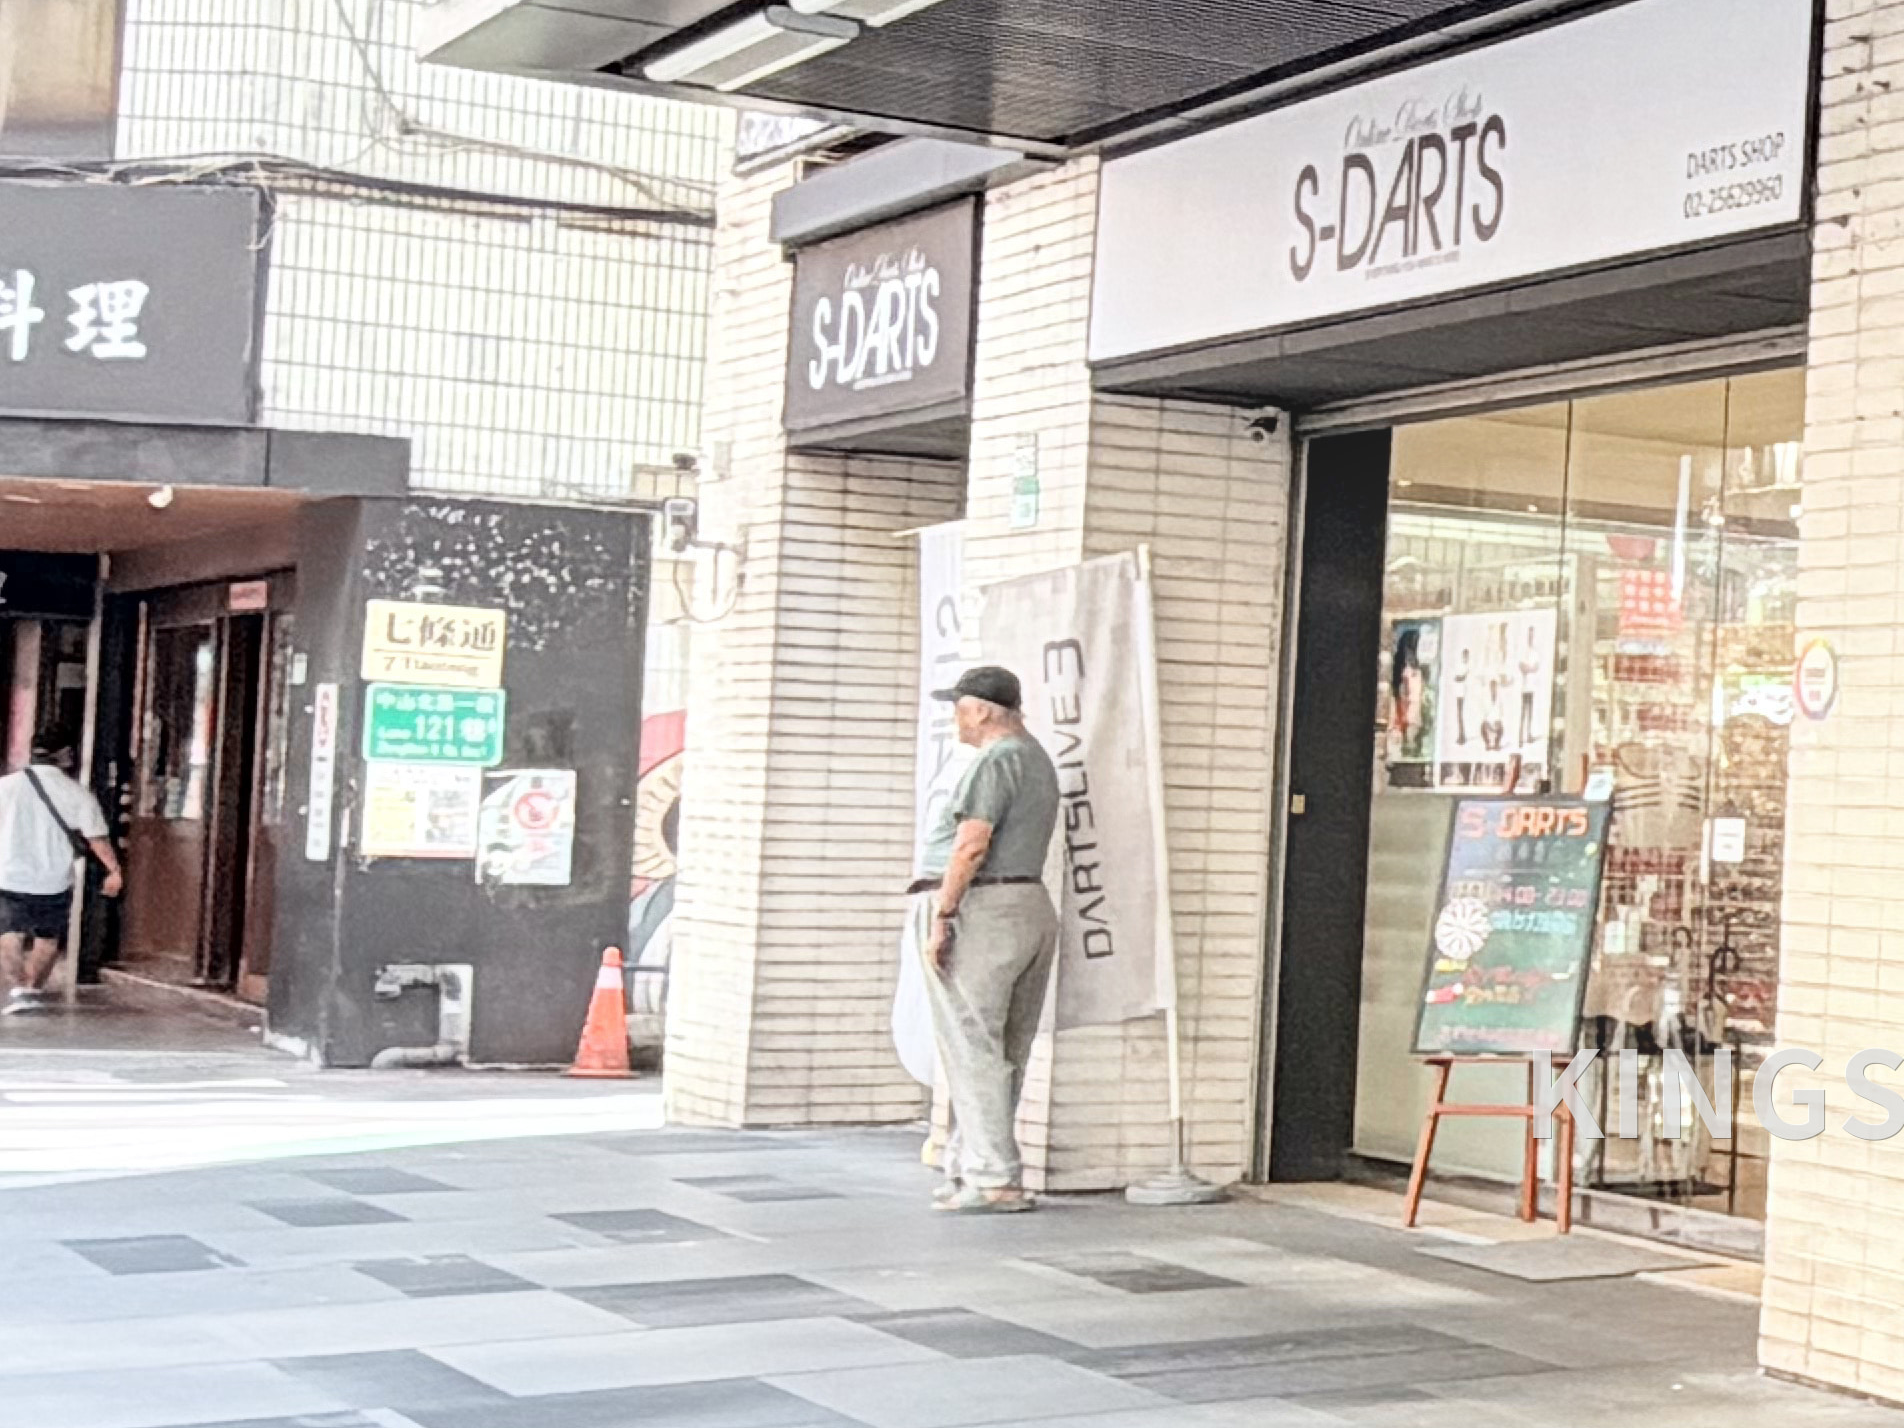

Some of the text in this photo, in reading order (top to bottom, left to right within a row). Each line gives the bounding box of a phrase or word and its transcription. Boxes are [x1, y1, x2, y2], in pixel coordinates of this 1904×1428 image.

[1289, 114, 1506, 281] S-DARTS
[1687, 131, 1785, 179] DARTS SHOP
[809, 268, 939, 390] S-DARTS
[415, 715, 455, 741] 121
[1043, 637, 1115, 960] DARTSLIVE 3
